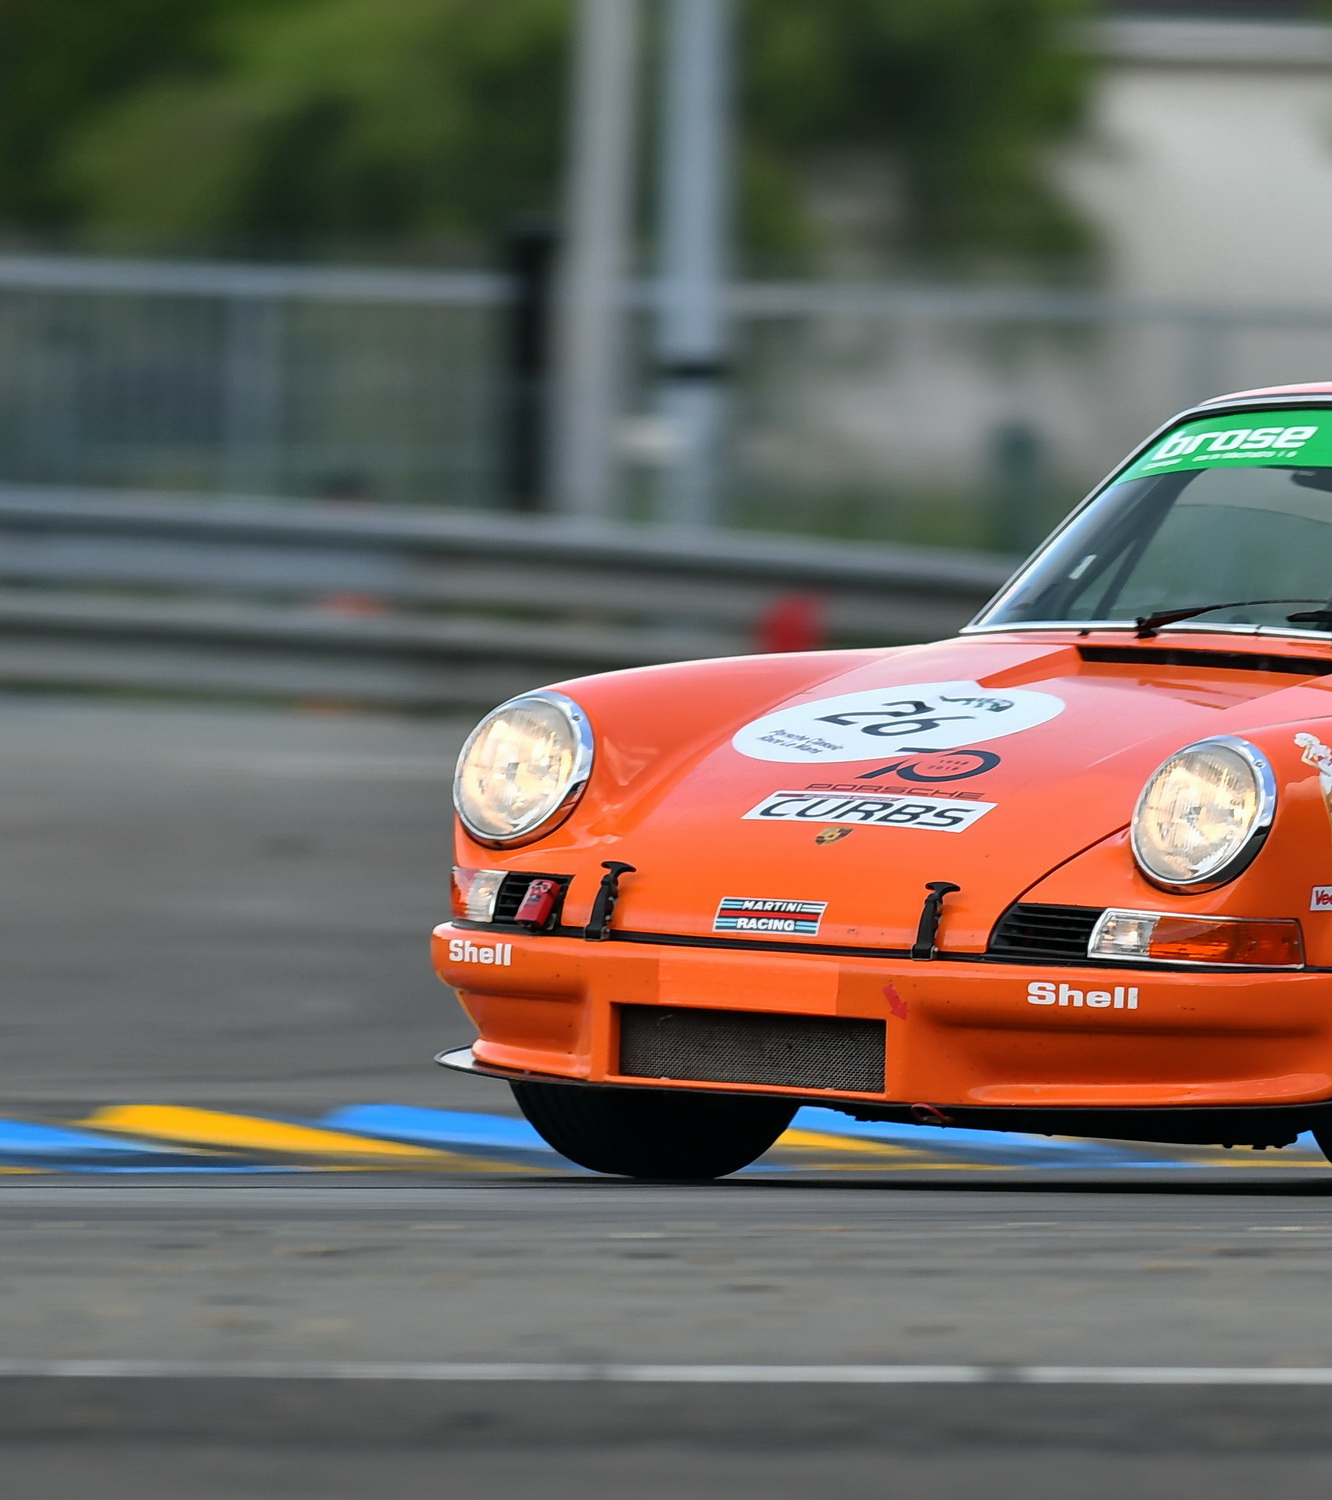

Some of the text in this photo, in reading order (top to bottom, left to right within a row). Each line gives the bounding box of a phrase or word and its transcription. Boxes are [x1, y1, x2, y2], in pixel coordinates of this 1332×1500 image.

[1151, 426, 1318, 460] brose
[814, 700, 976, 737] 26
[805, 783, 985, 800] PORSCHE
[759, 798, 977, 827] CURBS
[742, 901, 803, 913] MARTINI
[736, 917, 795, 931] RACING
[449, 939, 512, 966] Shell
[1027, 982, 1139, 1010] Shell
